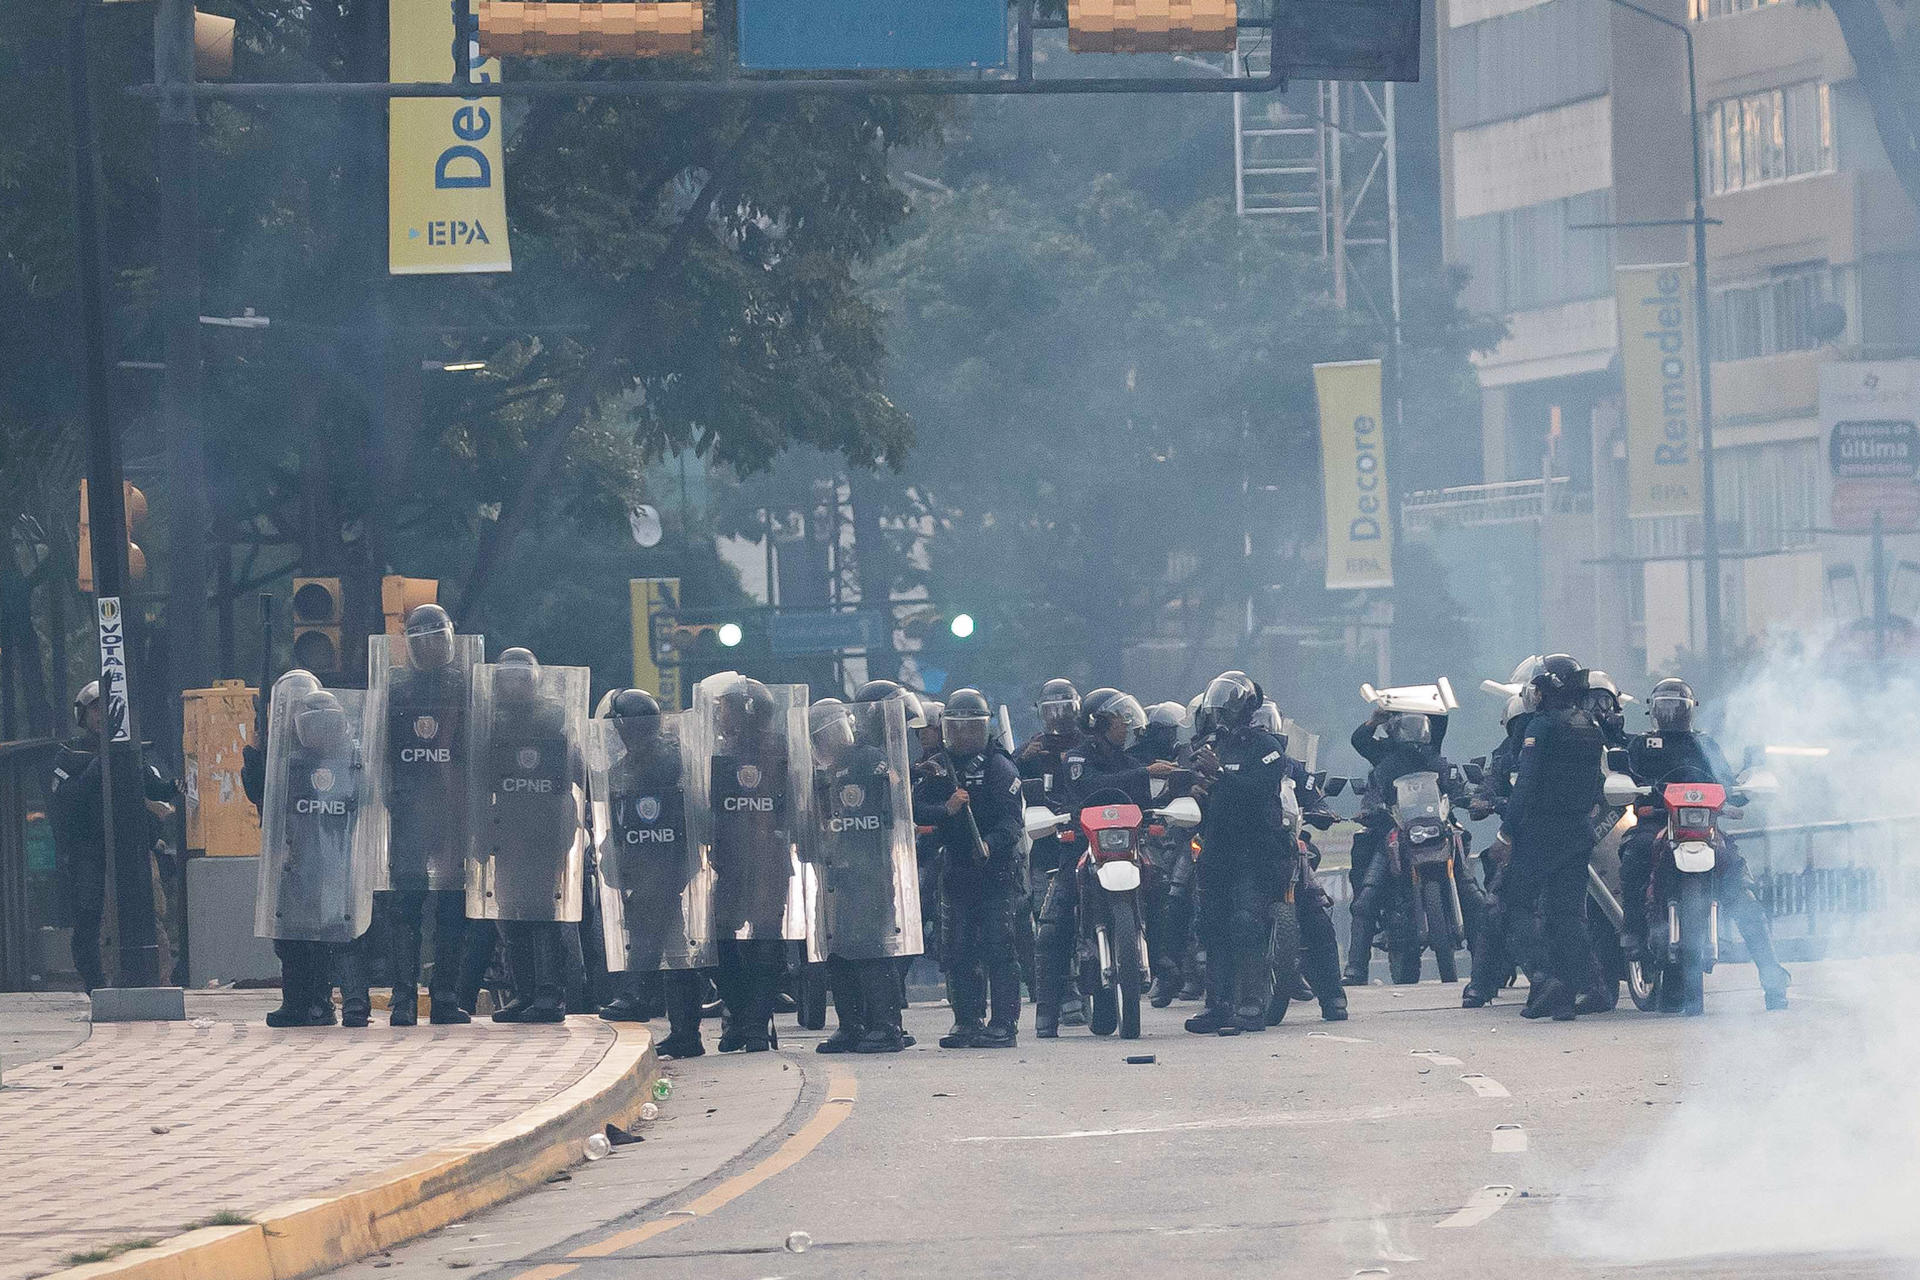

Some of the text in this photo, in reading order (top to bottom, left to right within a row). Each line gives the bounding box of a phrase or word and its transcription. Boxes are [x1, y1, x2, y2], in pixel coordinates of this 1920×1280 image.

[428, 219, 490, 246] EPA
[1641, 271, 1690, 466] Remodele
[1841, 439, 1908, 457] última
[1350, 415, 1381, 542] Decore
[101, 623, 124, 667] VOTA
[401, 748, 451, 763] CPNB
[503, 778, 552, 793] CPNB
[296, 799, 346, 815] CPNB
[724, 797, 774, 812] CPNB
[830, 816, 880, 833] CPNB
[1593, 810, 1620, 840] PNB
[626, 828, 675, 844] CPNB
